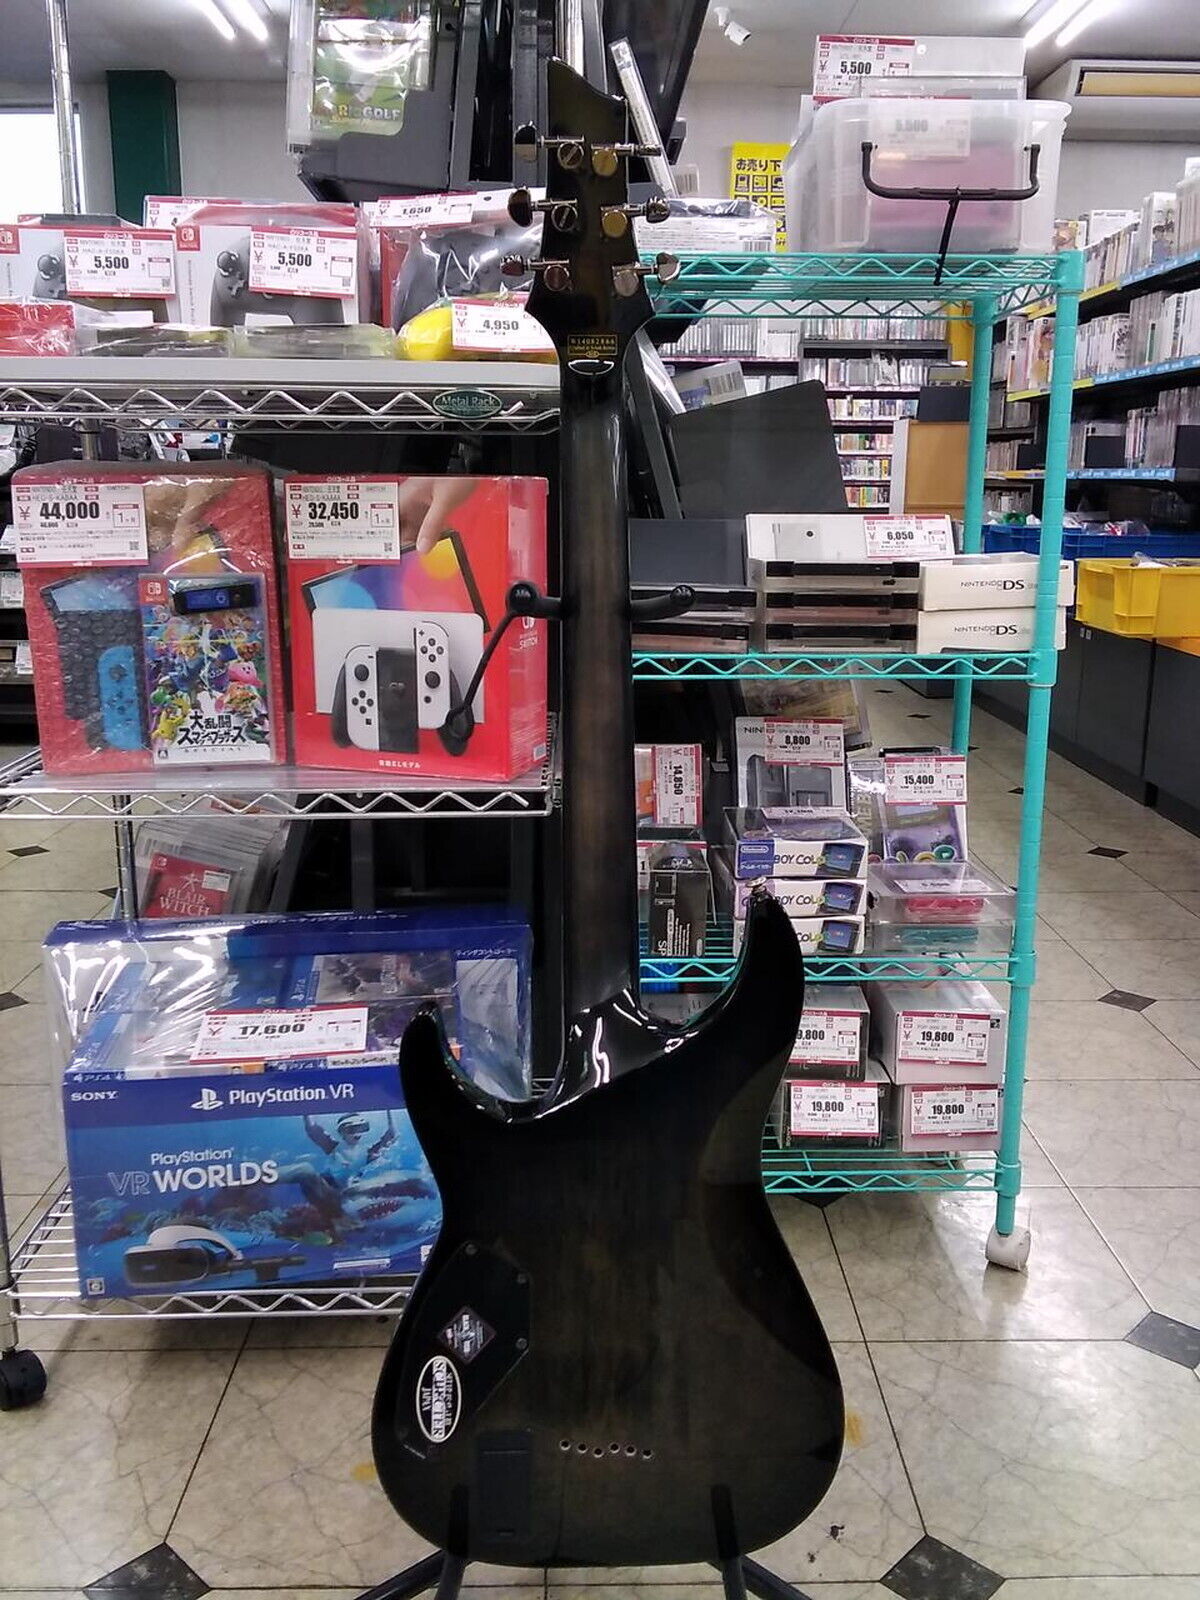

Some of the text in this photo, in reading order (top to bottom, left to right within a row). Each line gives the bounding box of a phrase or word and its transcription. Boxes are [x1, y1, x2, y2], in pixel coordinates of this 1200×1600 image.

[840, 61, 872, 75] 5,500
[362, 106, 401, 121] GOLF
[402, 206, 432, 215] 1,650
[94, 256, 129, 269] 5,500
[278, 252, 312, 266] 5,500
[483, 320, 519, 331] 4,950
[441, 396, 469, 406] Metal
[19, 502, 100, 520] ¥ 44,000
[291, 502, 359, 520] ¥ 32,450
[887, 531, 914, 541] 6,050
[1003, 580, 1025, 590] DS
[996, 624, 1018, 635] DS
[190, 711, 232, 730] 大乱闘
[673, 765, 684, 795] 14,850
[903, 775, 935, 785] 15,400
[775, 855, 795, 865] BOY
[167, 887, 207, 905] BLAIR
[160, 896, 210, 916] WITCH
[239, 1023, 306, 1036] 17,600
[796, 1029, 825, 1041] 9,800
[921, 1031, 954, 1042] 19,800
[71, 1090, 119, 1101] SONY
[229, 1083, 354, 1108] PlayStation VR
[811, 1101, 844, 1112] 19,800
[932, 1104, 965, 1115] 19,800
[151, 1149, 233, 1166] PlayStation
[108, 1159, 279, 1197] VR WORLDS
